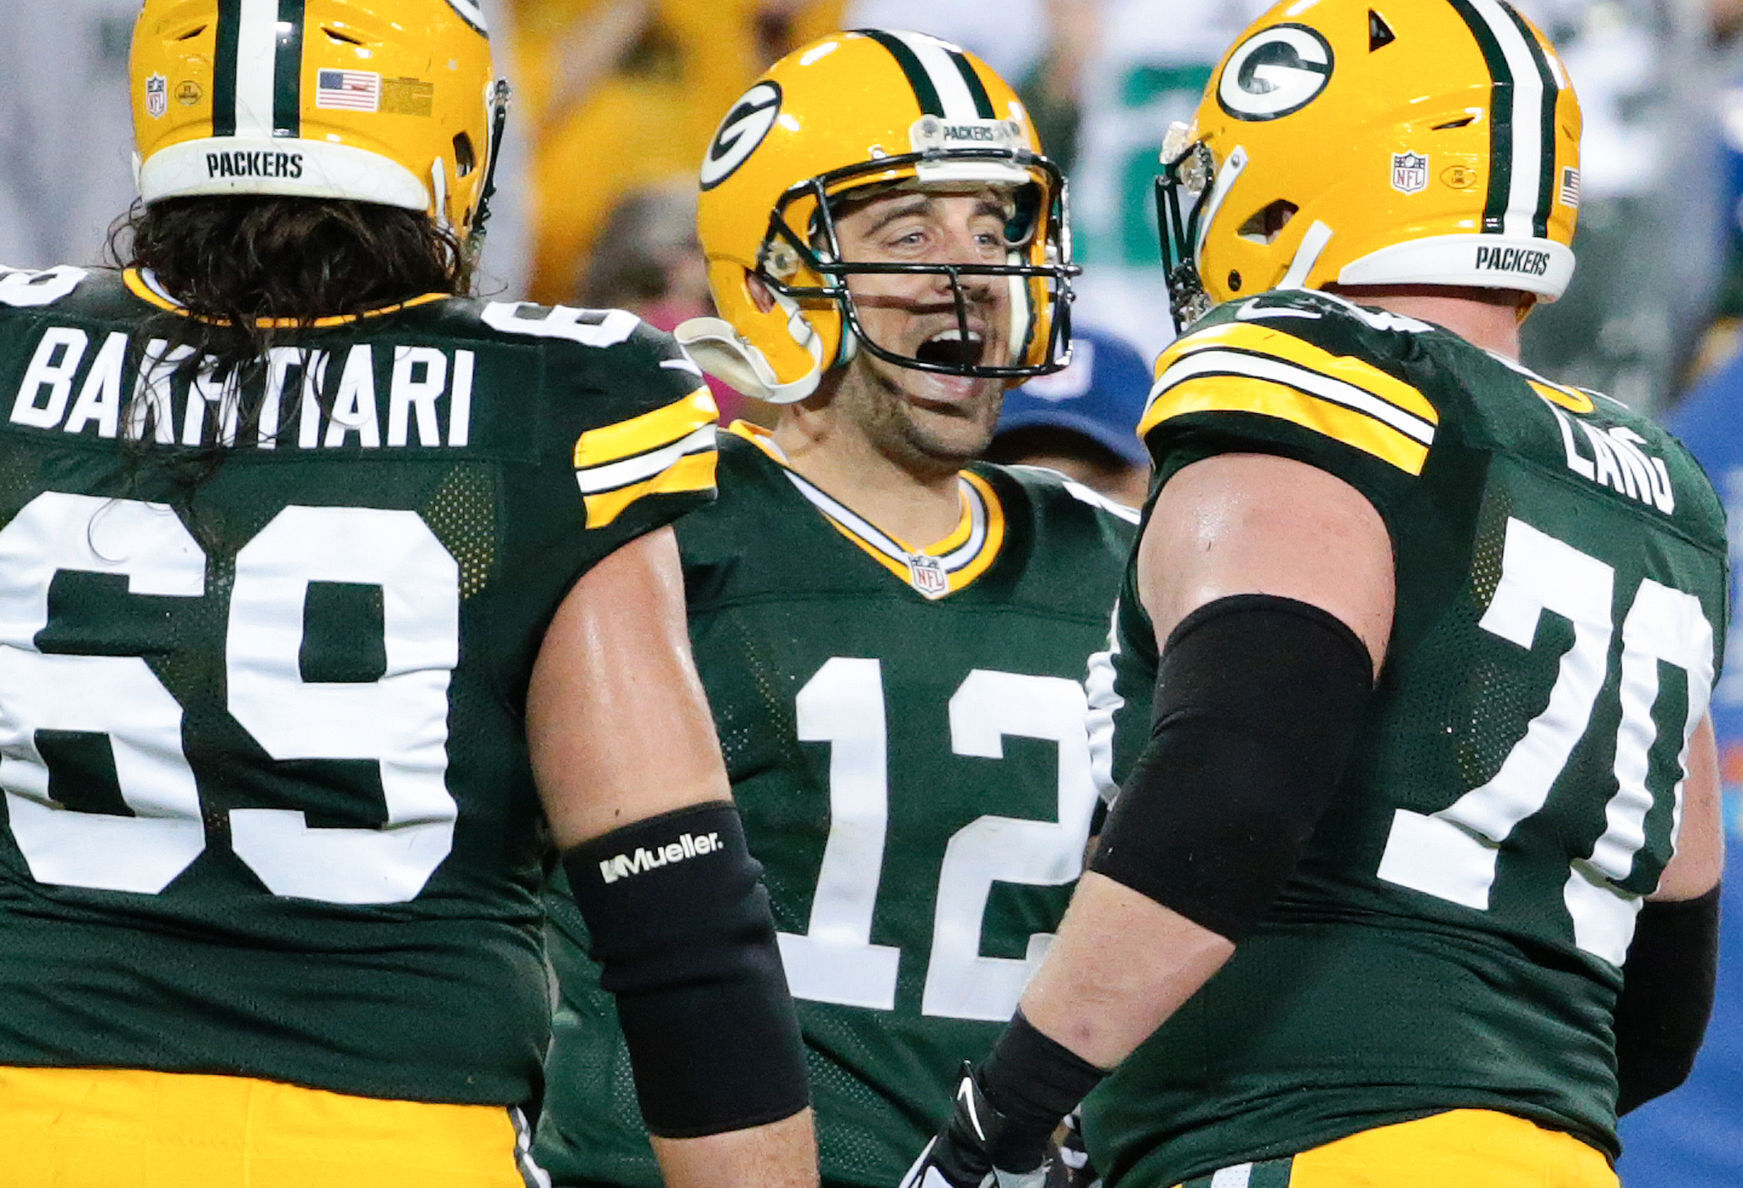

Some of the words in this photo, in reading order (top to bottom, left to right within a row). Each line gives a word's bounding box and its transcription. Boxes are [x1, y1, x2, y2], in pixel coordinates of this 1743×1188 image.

[1218, 24, 1334, 121] G
[206, 151, 303, 178] PACKERS
[944, 126, 994, 140] PACKERS
[1396, 169, 1421, 187] NFL
[1475, 246, 1550, 275] PACKERS
[10, 327, 475, 450] BAKHTIARI
[917, 569, 943, 588] NFL
[0, 490, 459, 903] 69
[1377, 517, 1715, 968] 70
[777, 656, 1099, 1020] 12
